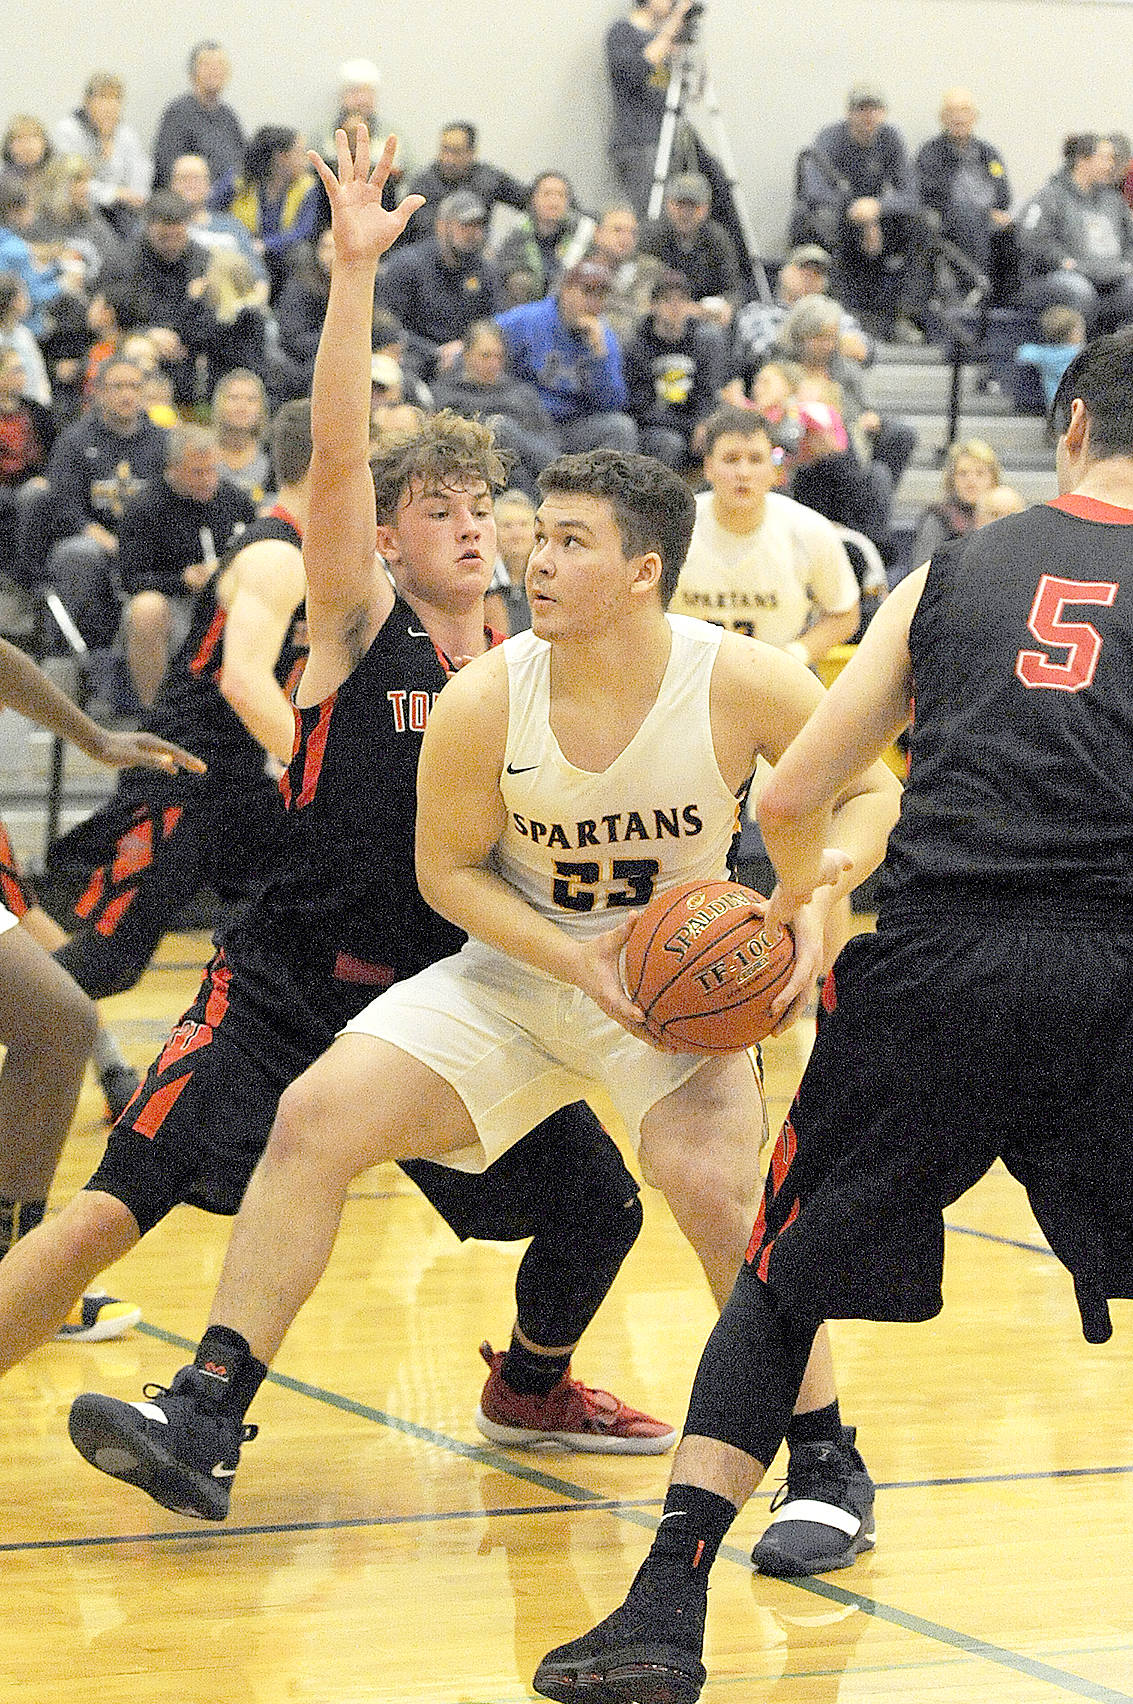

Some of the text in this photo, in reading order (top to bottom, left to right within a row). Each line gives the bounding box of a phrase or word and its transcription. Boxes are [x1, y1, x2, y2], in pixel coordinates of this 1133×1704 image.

[1015, 574, 1119, 693] 5
[387, 690, 440, 733] TO
[513, 804, 703, 849] SPARTANS
[552, 857, 661, 912] 23
[663, 888, 762, 962] SPALDIN
